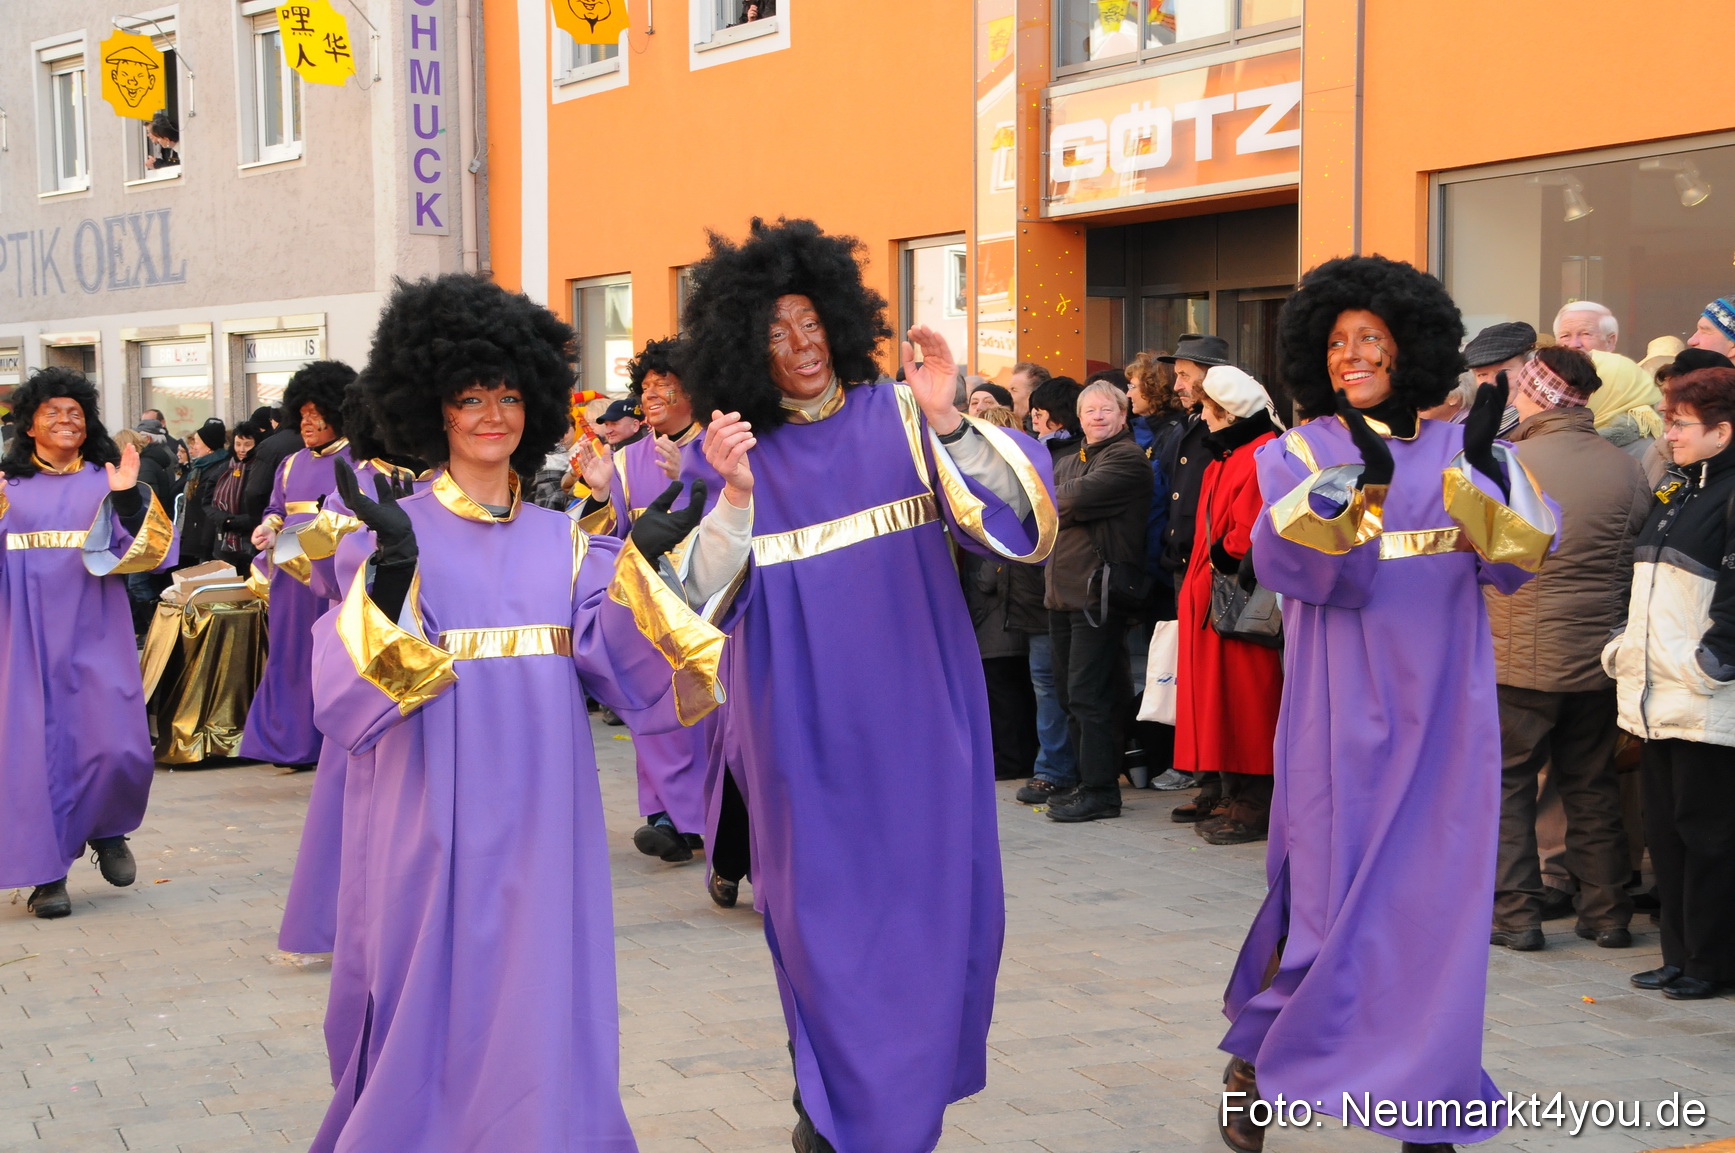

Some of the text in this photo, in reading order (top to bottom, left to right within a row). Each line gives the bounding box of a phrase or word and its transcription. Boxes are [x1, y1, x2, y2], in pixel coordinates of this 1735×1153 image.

[409, 0, 443, 228] HMUCK
[1050, 80, 1300, 183] GÖTZ
[73, 207, 187, 295] OEXL
